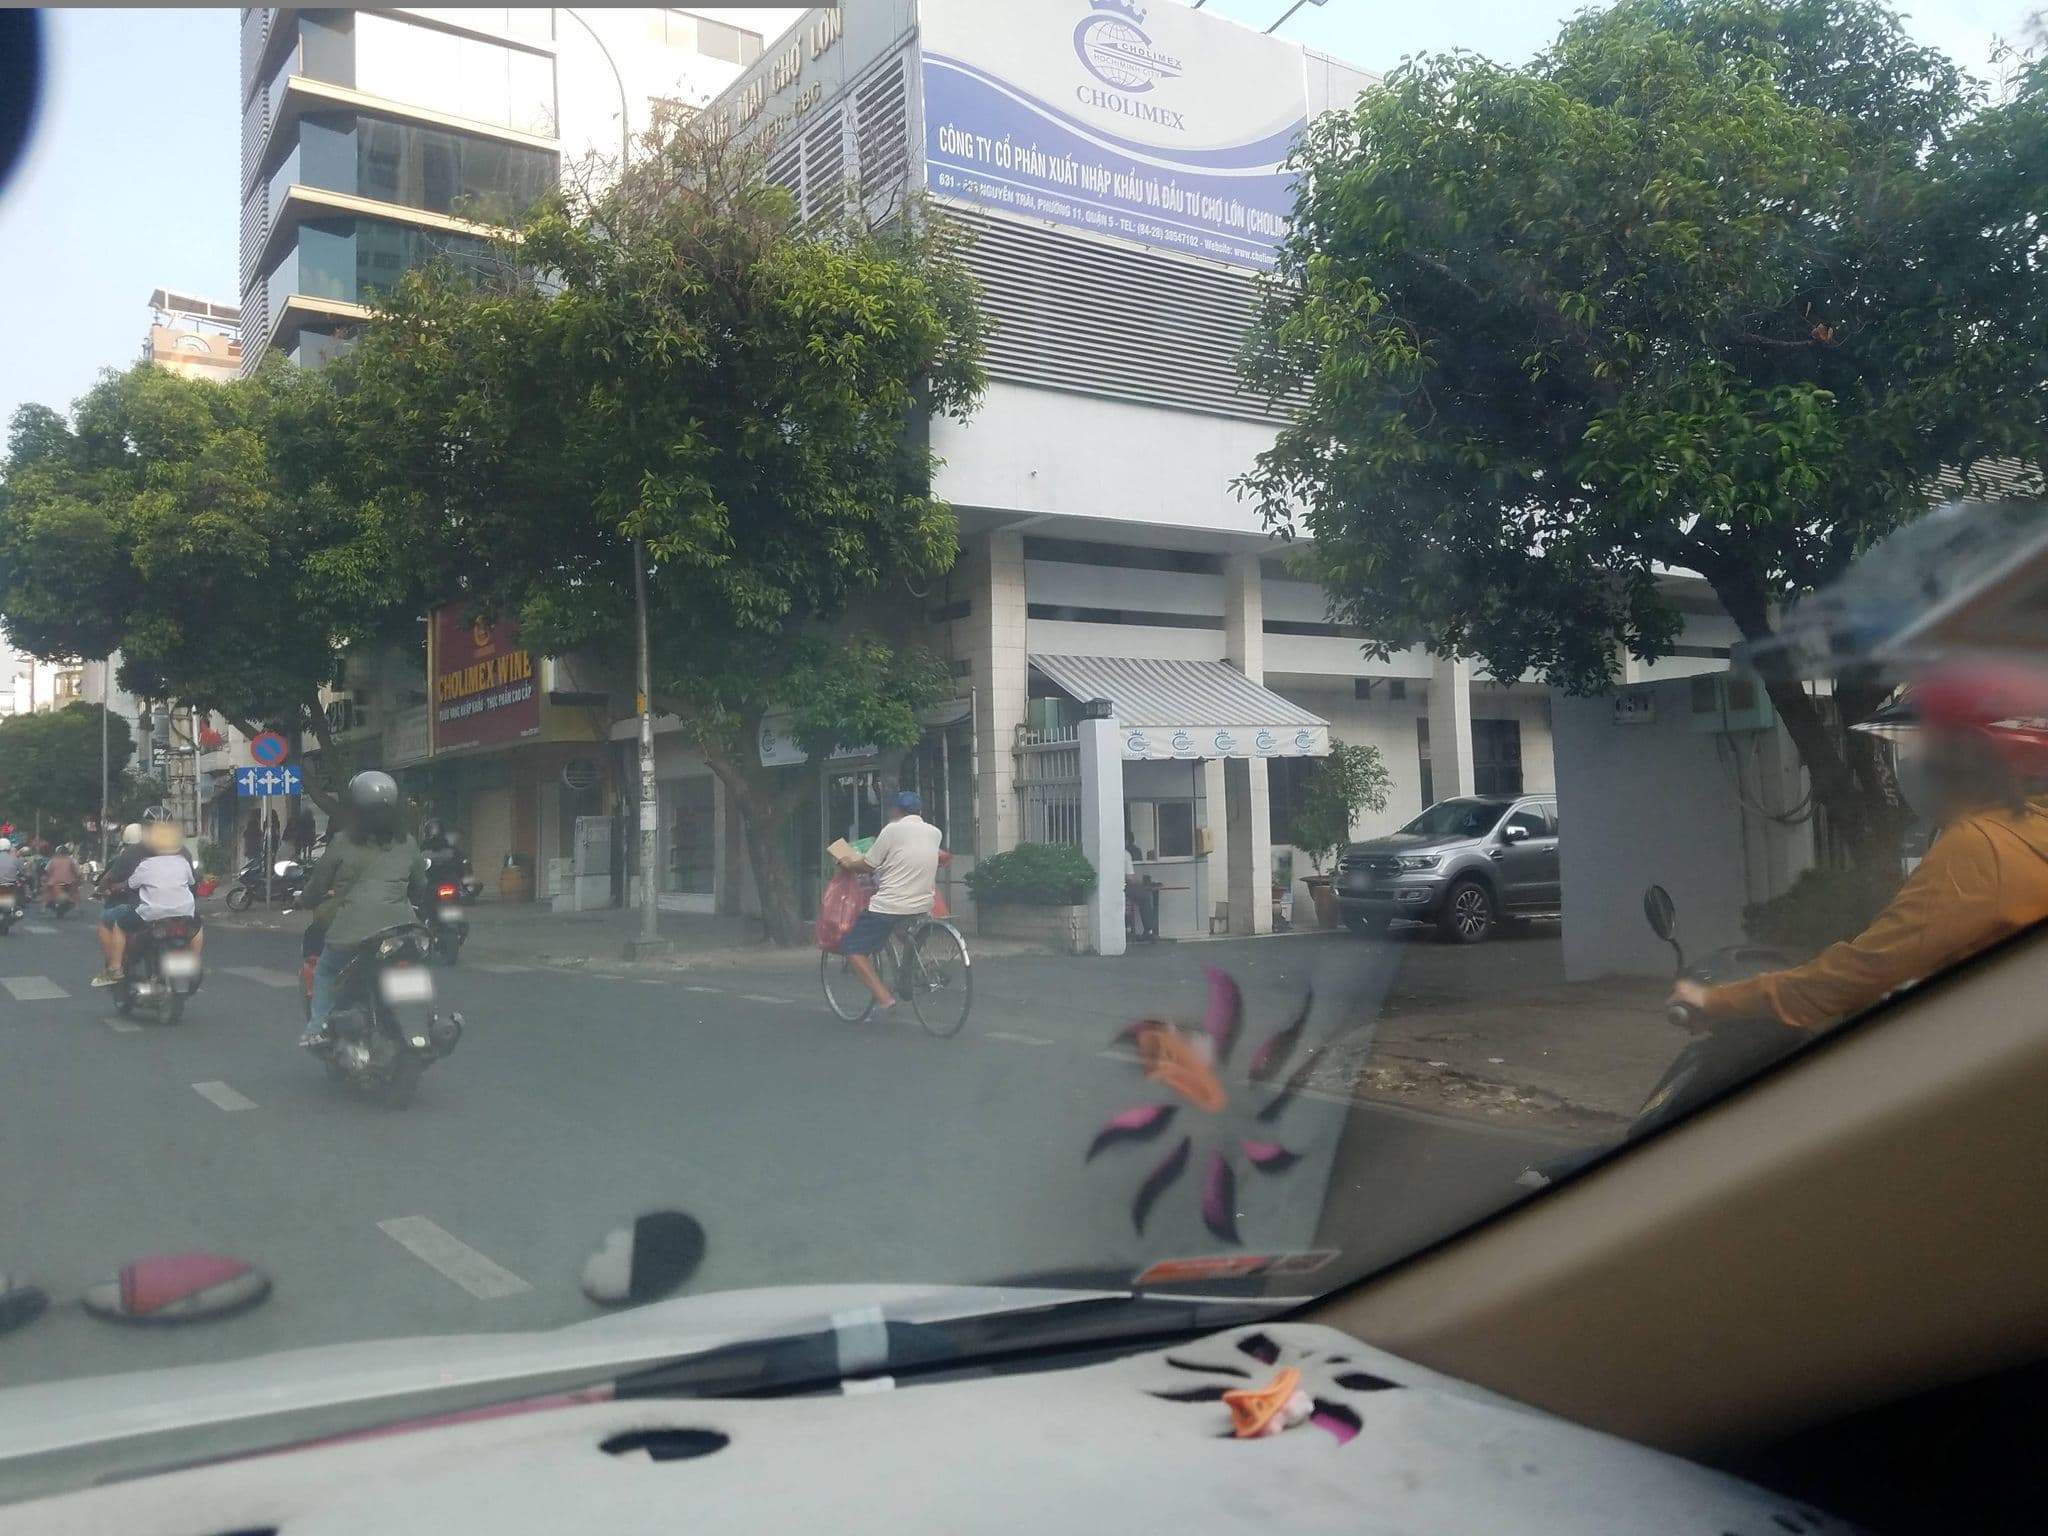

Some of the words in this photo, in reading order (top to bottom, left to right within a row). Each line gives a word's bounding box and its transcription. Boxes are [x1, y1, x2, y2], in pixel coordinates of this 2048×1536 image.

[1121, 42, 1182, 68] CHOLIMEX
[1076, 85, 1185, 131] CHOLIMEX
[939, 122, 974, 159] CÔNG
[976, 135, 992, 163] TY
[995, 132, 1012, 168] CỔ
[1014, 142, 1046, 178] PHẦN
[1049, 152, 1079, 187] XUẤT
[1081, 162, 1111, 198] NHẬP
[1114, 166, 1144, 204] KHẨU
[1145, 176, 1161, 208] VÀ
[1185, 190, 1201, 217] TƯ
[1201, 195, 1223, 227] CHỢ
[1224, 198, 1245, 229] LỚN
[938, 172, 955, 188] 631
[980, 182, 1014, 204] NGUYỄN
[1107, 215, 1115, 228] 5
[1119, 217, 1137, 233] TEL:
[1204, 238, 1234, 256] Website:
[439, 659, 496, 703] CHOLIMEX
